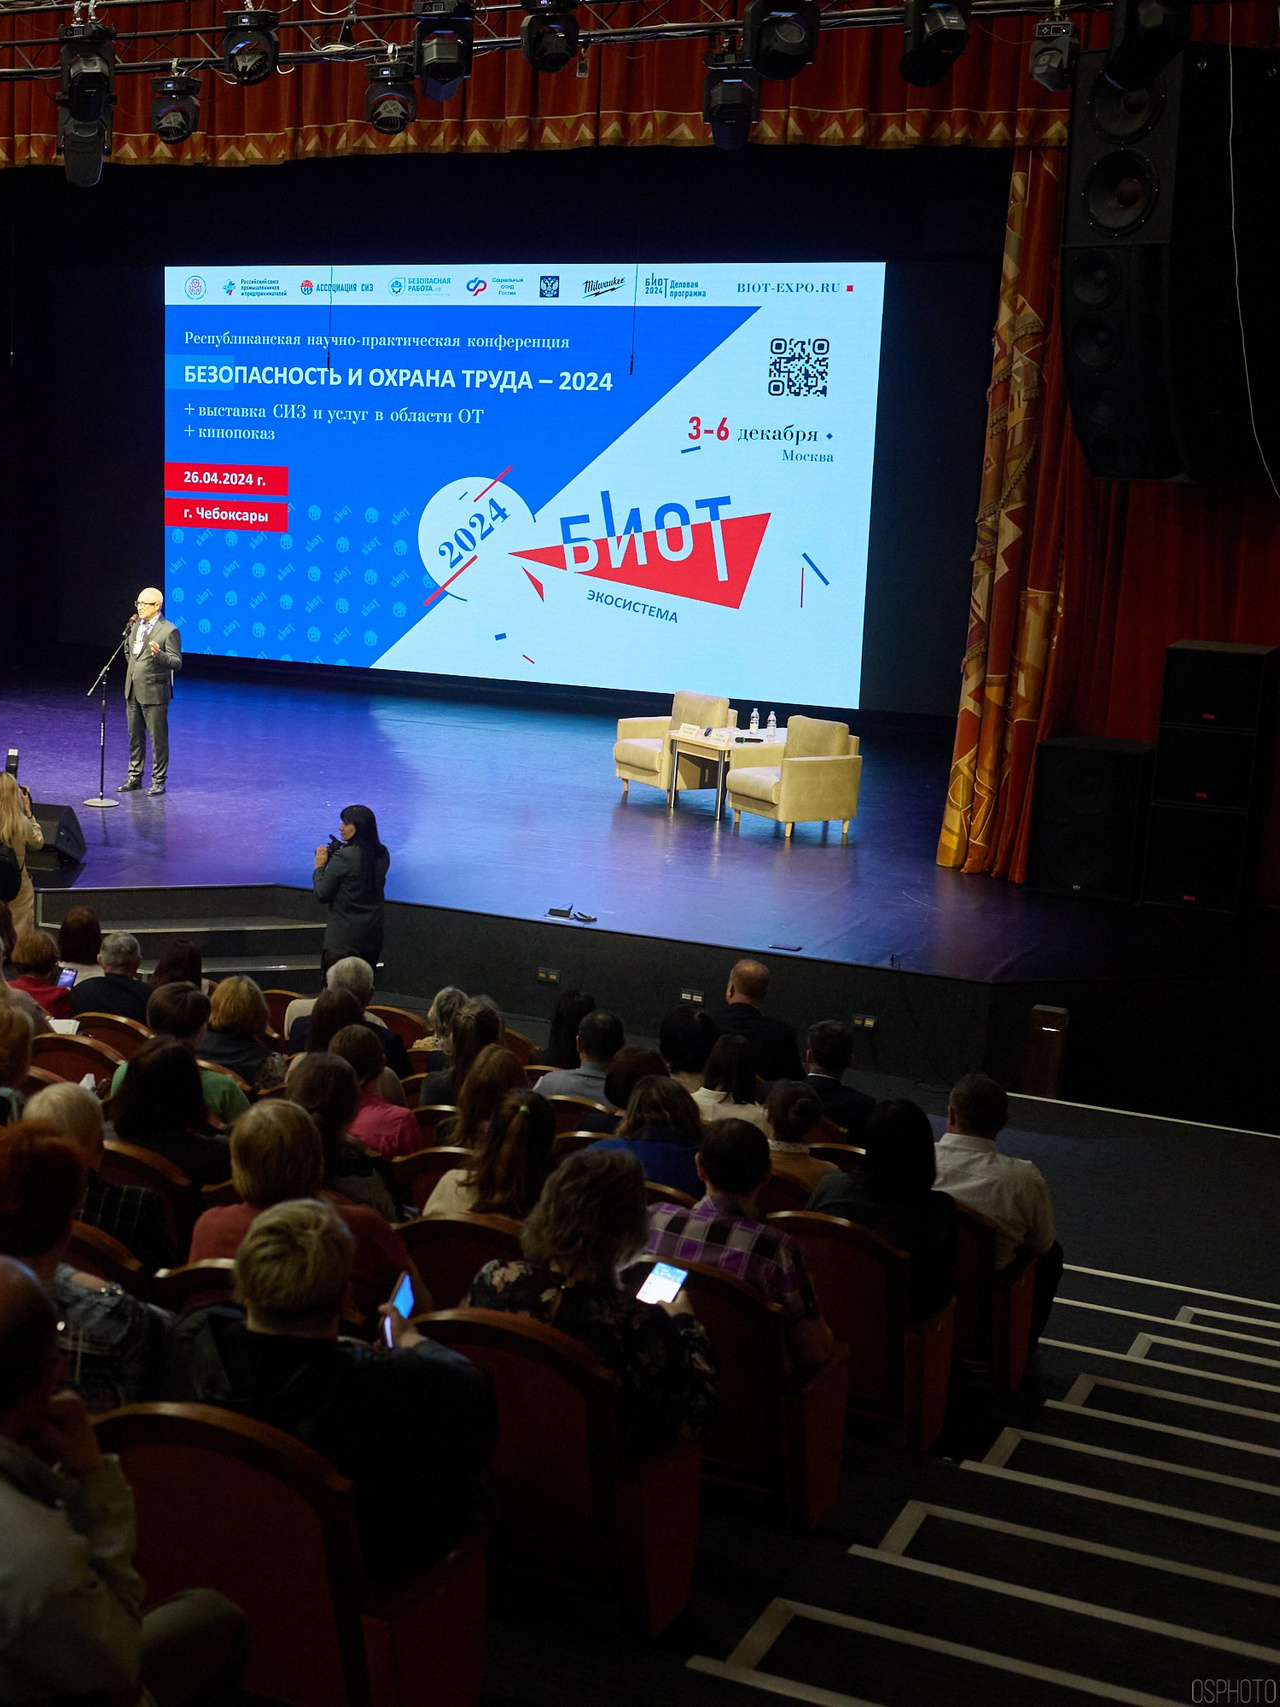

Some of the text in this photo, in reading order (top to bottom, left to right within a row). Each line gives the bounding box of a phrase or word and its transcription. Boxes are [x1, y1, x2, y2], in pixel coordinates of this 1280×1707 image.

[315, 283, 374, 294] АССОЦИАЦИЯ СИЗ
[408, 277, 452, 285] БЕЗОПАСНАЯ
[669, 280, 699, 289] Деловая
[737, 282, 841, 294] BIOT-EXPO.RU
[184, 331, 569, 352] Республиканская научно-практическая конференция
[184, 365, 342, 387] БЕЗОПАСНОСТЬ
[348, 368, 363, 386] И
[368, 368, 456, 389] ОХРАНА
[461, 369, 534, 393] ТРУДА
[558, 371, 614, 392] 2024
[273, 404, 307, 419] СИЗ
[313, 409, 323, 420] и
[327, 409, 369, 425] услуг
[375, 411, 384, 421] в
[390, 406, 452, 423] области
[458, 408, 485, 424] ОТ
[737, 424, 818, 445] декабря
[781, 449, 834, 462] Москва
[183, 470, 266, 486] 26.04.2024 г.
[183, 506, 269, 525] г. Чебоксары
[438, 497, 511, 569] 2024
[560, 490, 731, 582] БИОТ
[586, 589, 678, 624] ЭКОСИСТЕМА
